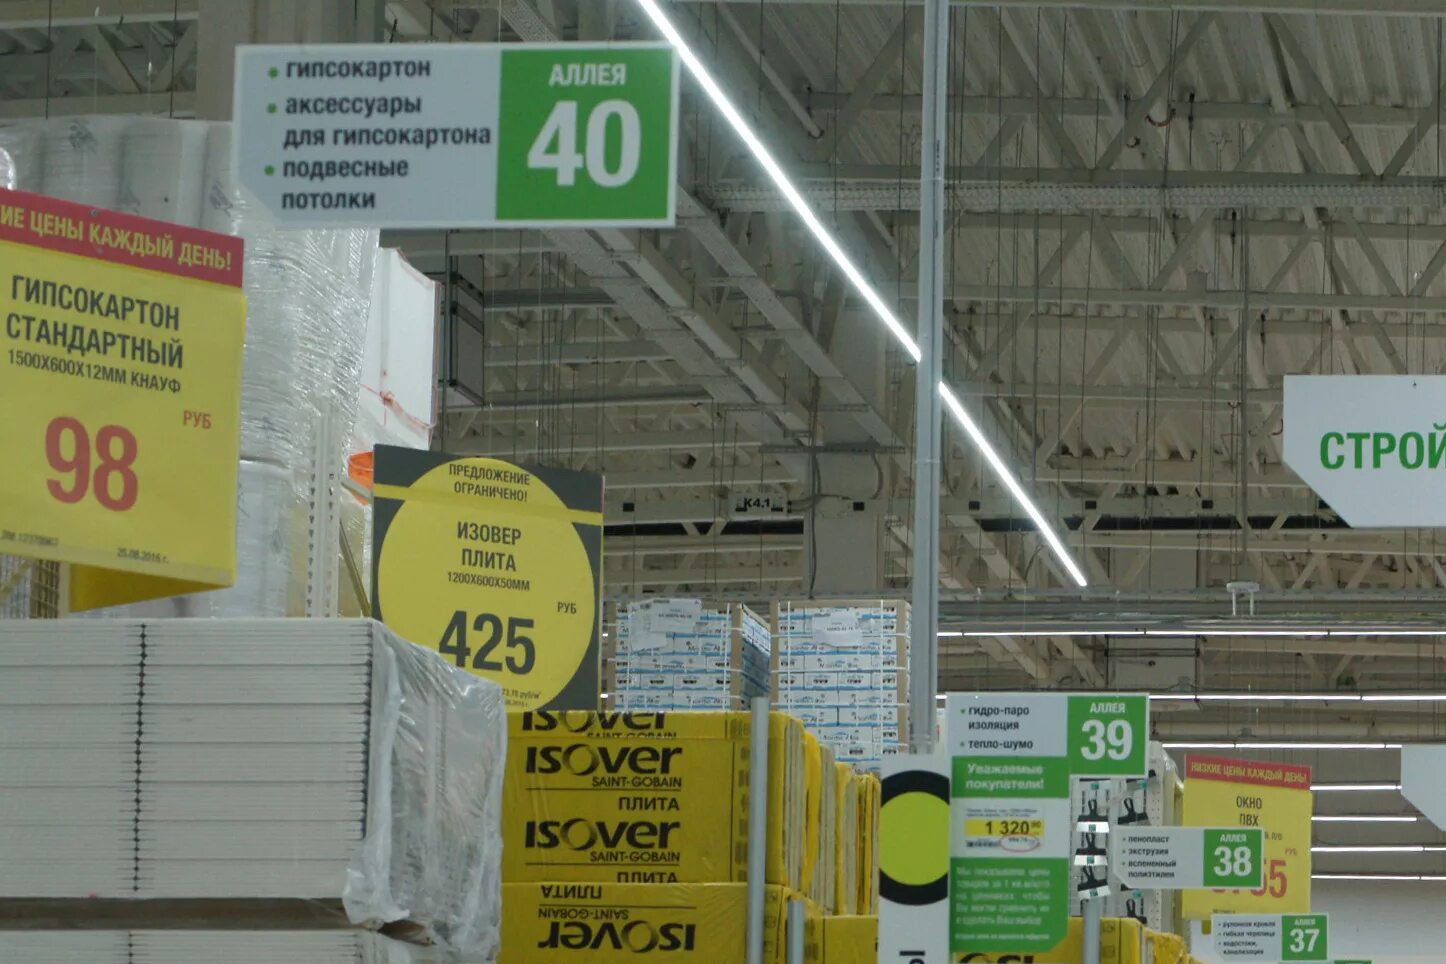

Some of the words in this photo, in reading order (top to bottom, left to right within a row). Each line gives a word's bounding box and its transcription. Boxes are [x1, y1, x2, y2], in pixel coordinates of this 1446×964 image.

[286, 60, 430, 80] гипсокартон
[549, 64, 626, 86] АЛЛЕЯ
[285, 97, 421, 116] аксессуары
[283, 129, 325, 149] для
[333, 127, 491, 148] гипсокартона
[527, 99, 641, 188] 40
[283, 161, 408, 181] подвесные
[282, 191, 376, 210] потолки
[30, 210, 83, 241] ЦЕНЫ
[89, 224, 174, 260] КАЖДЫЙ
[178, 242, 232, 271] ДЕНЬ!
[12, 274, 180, 331] ГИПСОКАРТОН
[6, 313, 184, 369] СТАНДАРТНЫЙ
[8, 350, 127, 384] 1500Х600Х12ММ
[130, 371, 181, 394] КНАУФ
[183, 410, 212, 430] РУБ
[45, 416, 139, 512] 98
[449, 463, 531, 486] ПРЕДЛОЖЕНИЕ
[454, 481, 528, 503] ОГРАНИЧЕНО!
[457, 521, 521, 546] ИЗОВЕР
[461, 548, 517, 572] ПЛИТА
[448, 571, 531, 592] 1200Х600Х50ММ
[557, 601, 577, 615] РУБ
[439, 610, 536, 675] 425
[968, 706, 1030, 717] гидро-паро
[1089, 702, 1126, 714] АЛЛЕЯ
[968, 721, 1019, 731] изоляция
[968, 740, 1034, 751] тепло-шумо
[1081, 719, 1133, 761] 39
[592, 777, 682, 787] SAINT-GOBAIN
[966, 779, 1044, 791] покупатели!
[618, 797, 680, 811] ПЛИТА
[1236, 796, 1263, 809] ОКНО
[985, 821, 993, 834] 1
[999, 821, 1030, 834] 320
[1239, 813, 1259, 826] ПВХ
[1128, 836, 1169, 844] пенопласт
[1220, 834, 1247, 842] АЛЛЕЯ
[590, 852, 680, 862] SAINT-GOBAIN
[1128, 848, 1169, 856] экструзия
[1213, 846, 1252, 876] 38
[617, 872, 678, 883] ПЛИТА
[1128, 871, 1175, 879] полиэтилен
[541, 885, 602, 899] ПЛИТА
[538, 908, 629, 920] SAINT-GOBAIN
[1290, 928, 1319, 953] 37
